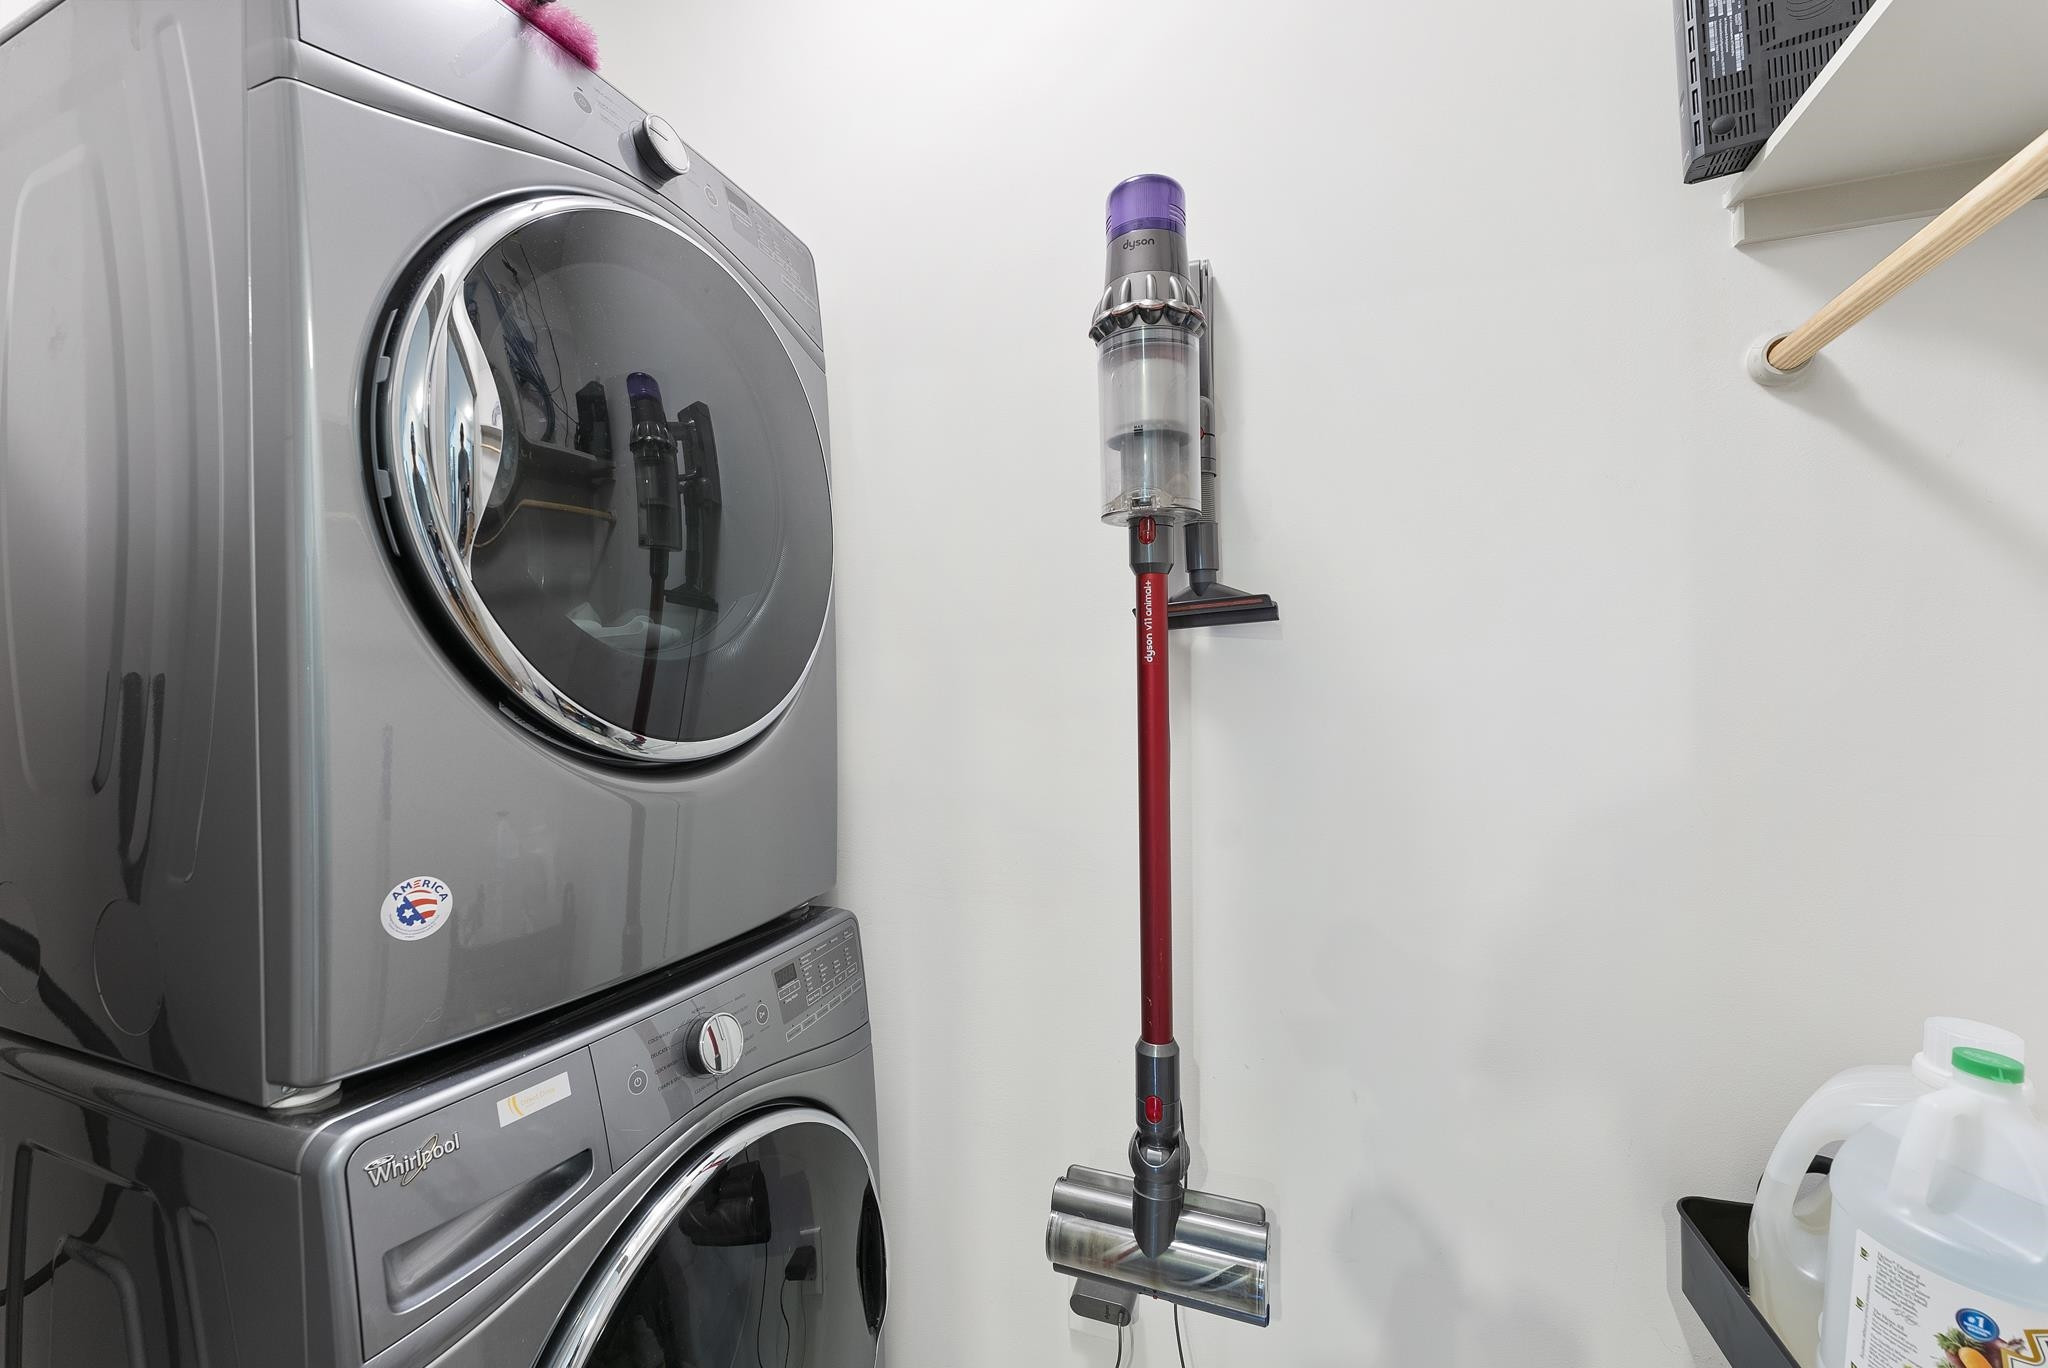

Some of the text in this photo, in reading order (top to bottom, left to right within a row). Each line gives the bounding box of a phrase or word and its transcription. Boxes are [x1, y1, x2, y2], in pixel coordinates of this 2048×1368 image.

[1122, 237, 1155, 251] dyson
[1144, 633, 1156, 663] dyson
[392, 879, 449, 903] AMERICA
[367, 1131, 461, 1188] Whirlpool
